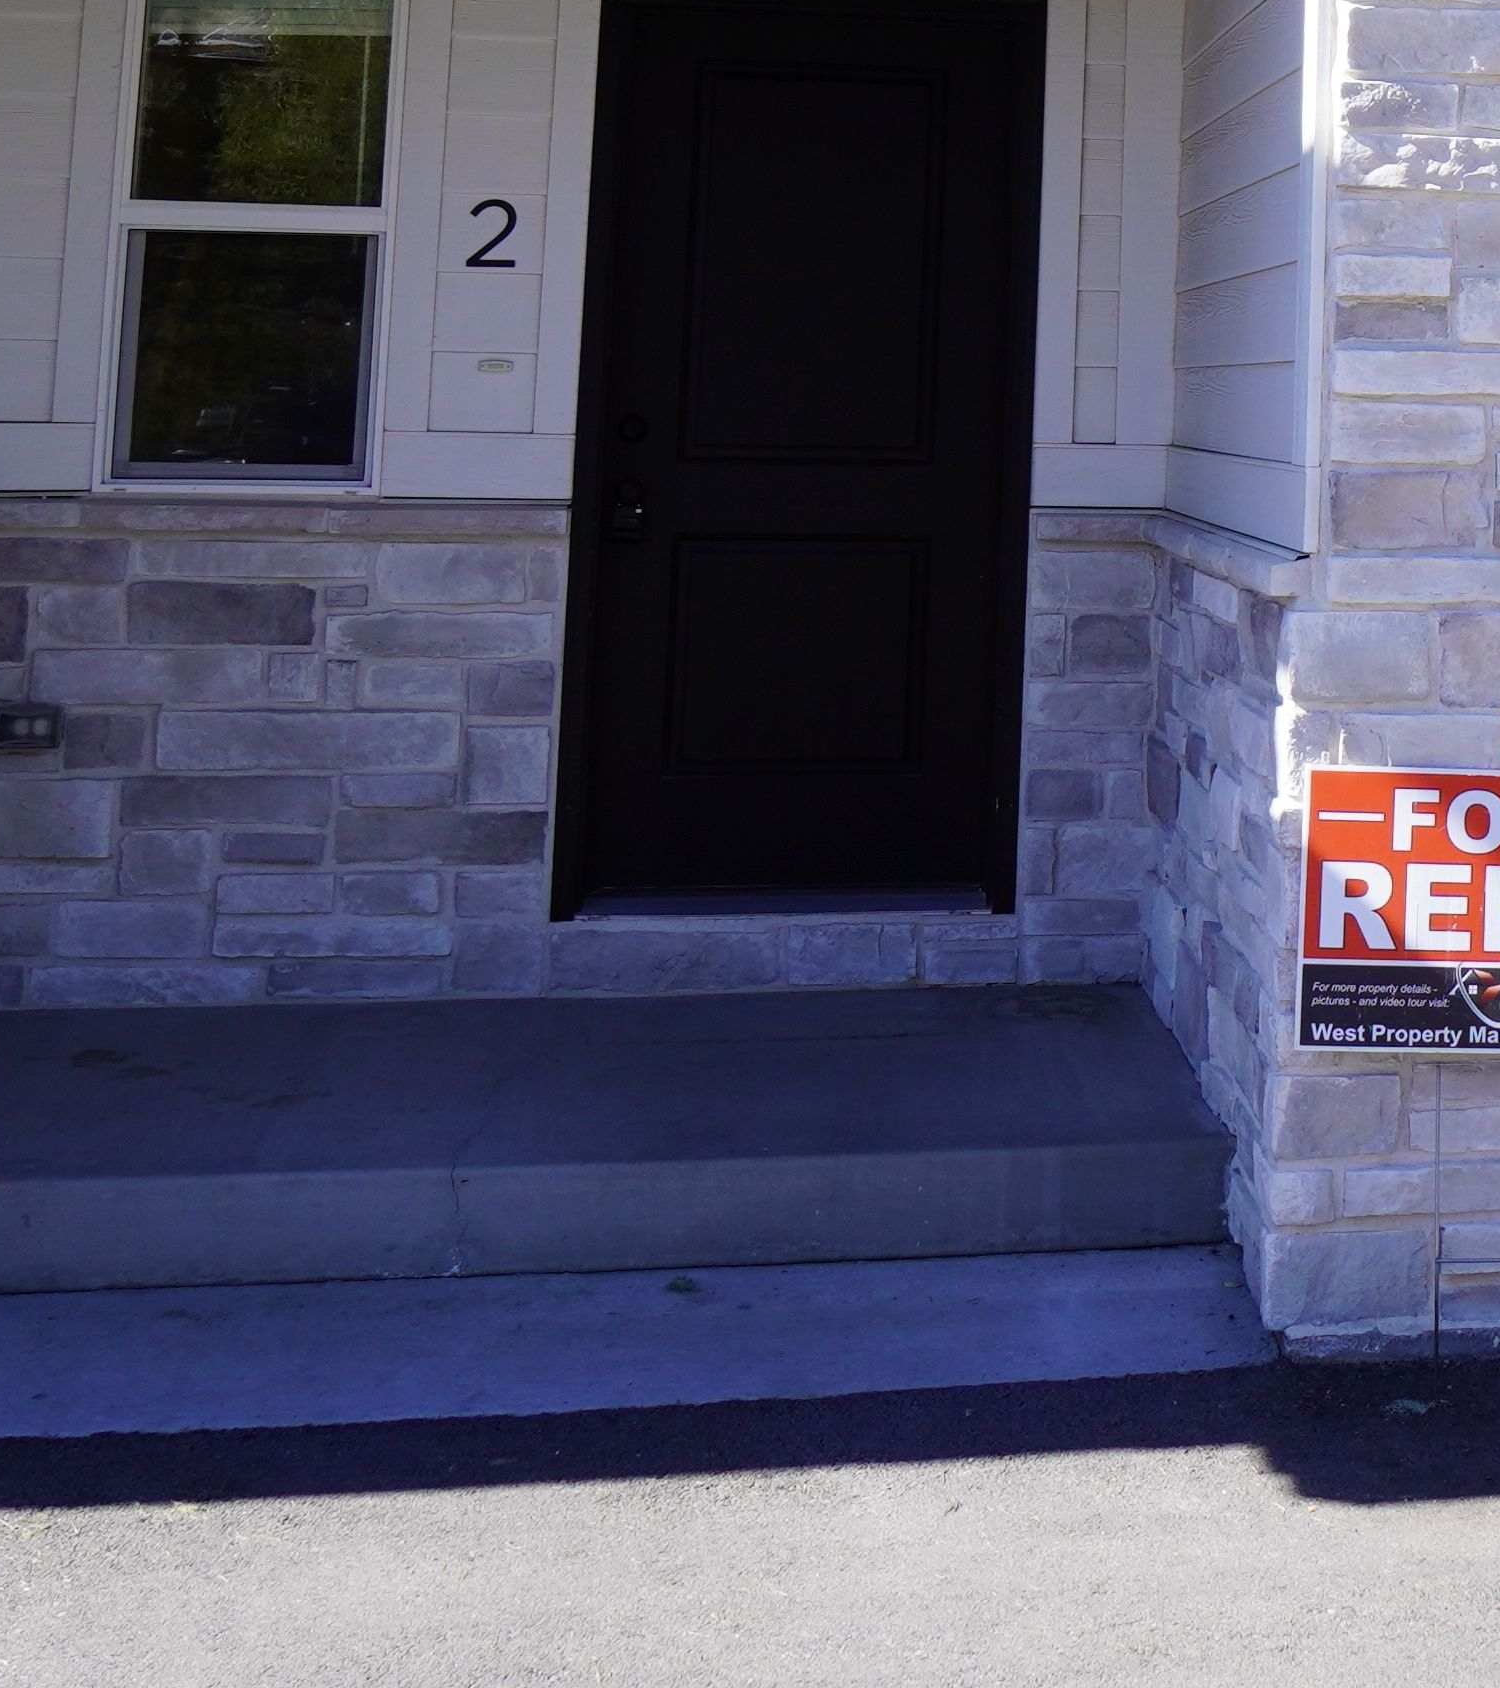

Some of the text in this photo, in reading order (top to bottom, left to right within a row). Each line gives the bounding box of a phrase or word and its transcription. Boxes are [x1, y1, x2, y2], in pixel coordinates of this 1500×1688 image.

[465, 198, 518, 268] 2
[1312, 981, 1330, 992] For
[1331, 984, 1356, 993] more
[1357, 983, 1398, 995] property
[1400, 984, 1432, 994] details
[1311, 995, 1350, 1007] pictures
[1359, 997, 1378, 1007] and
[1380, 997, 1406, 1007] video
[1407, 998, 1426, 1007] tour
[1311, 1023, 1366, 1042] West
[1371, 1024, 1463, 1048] Property
